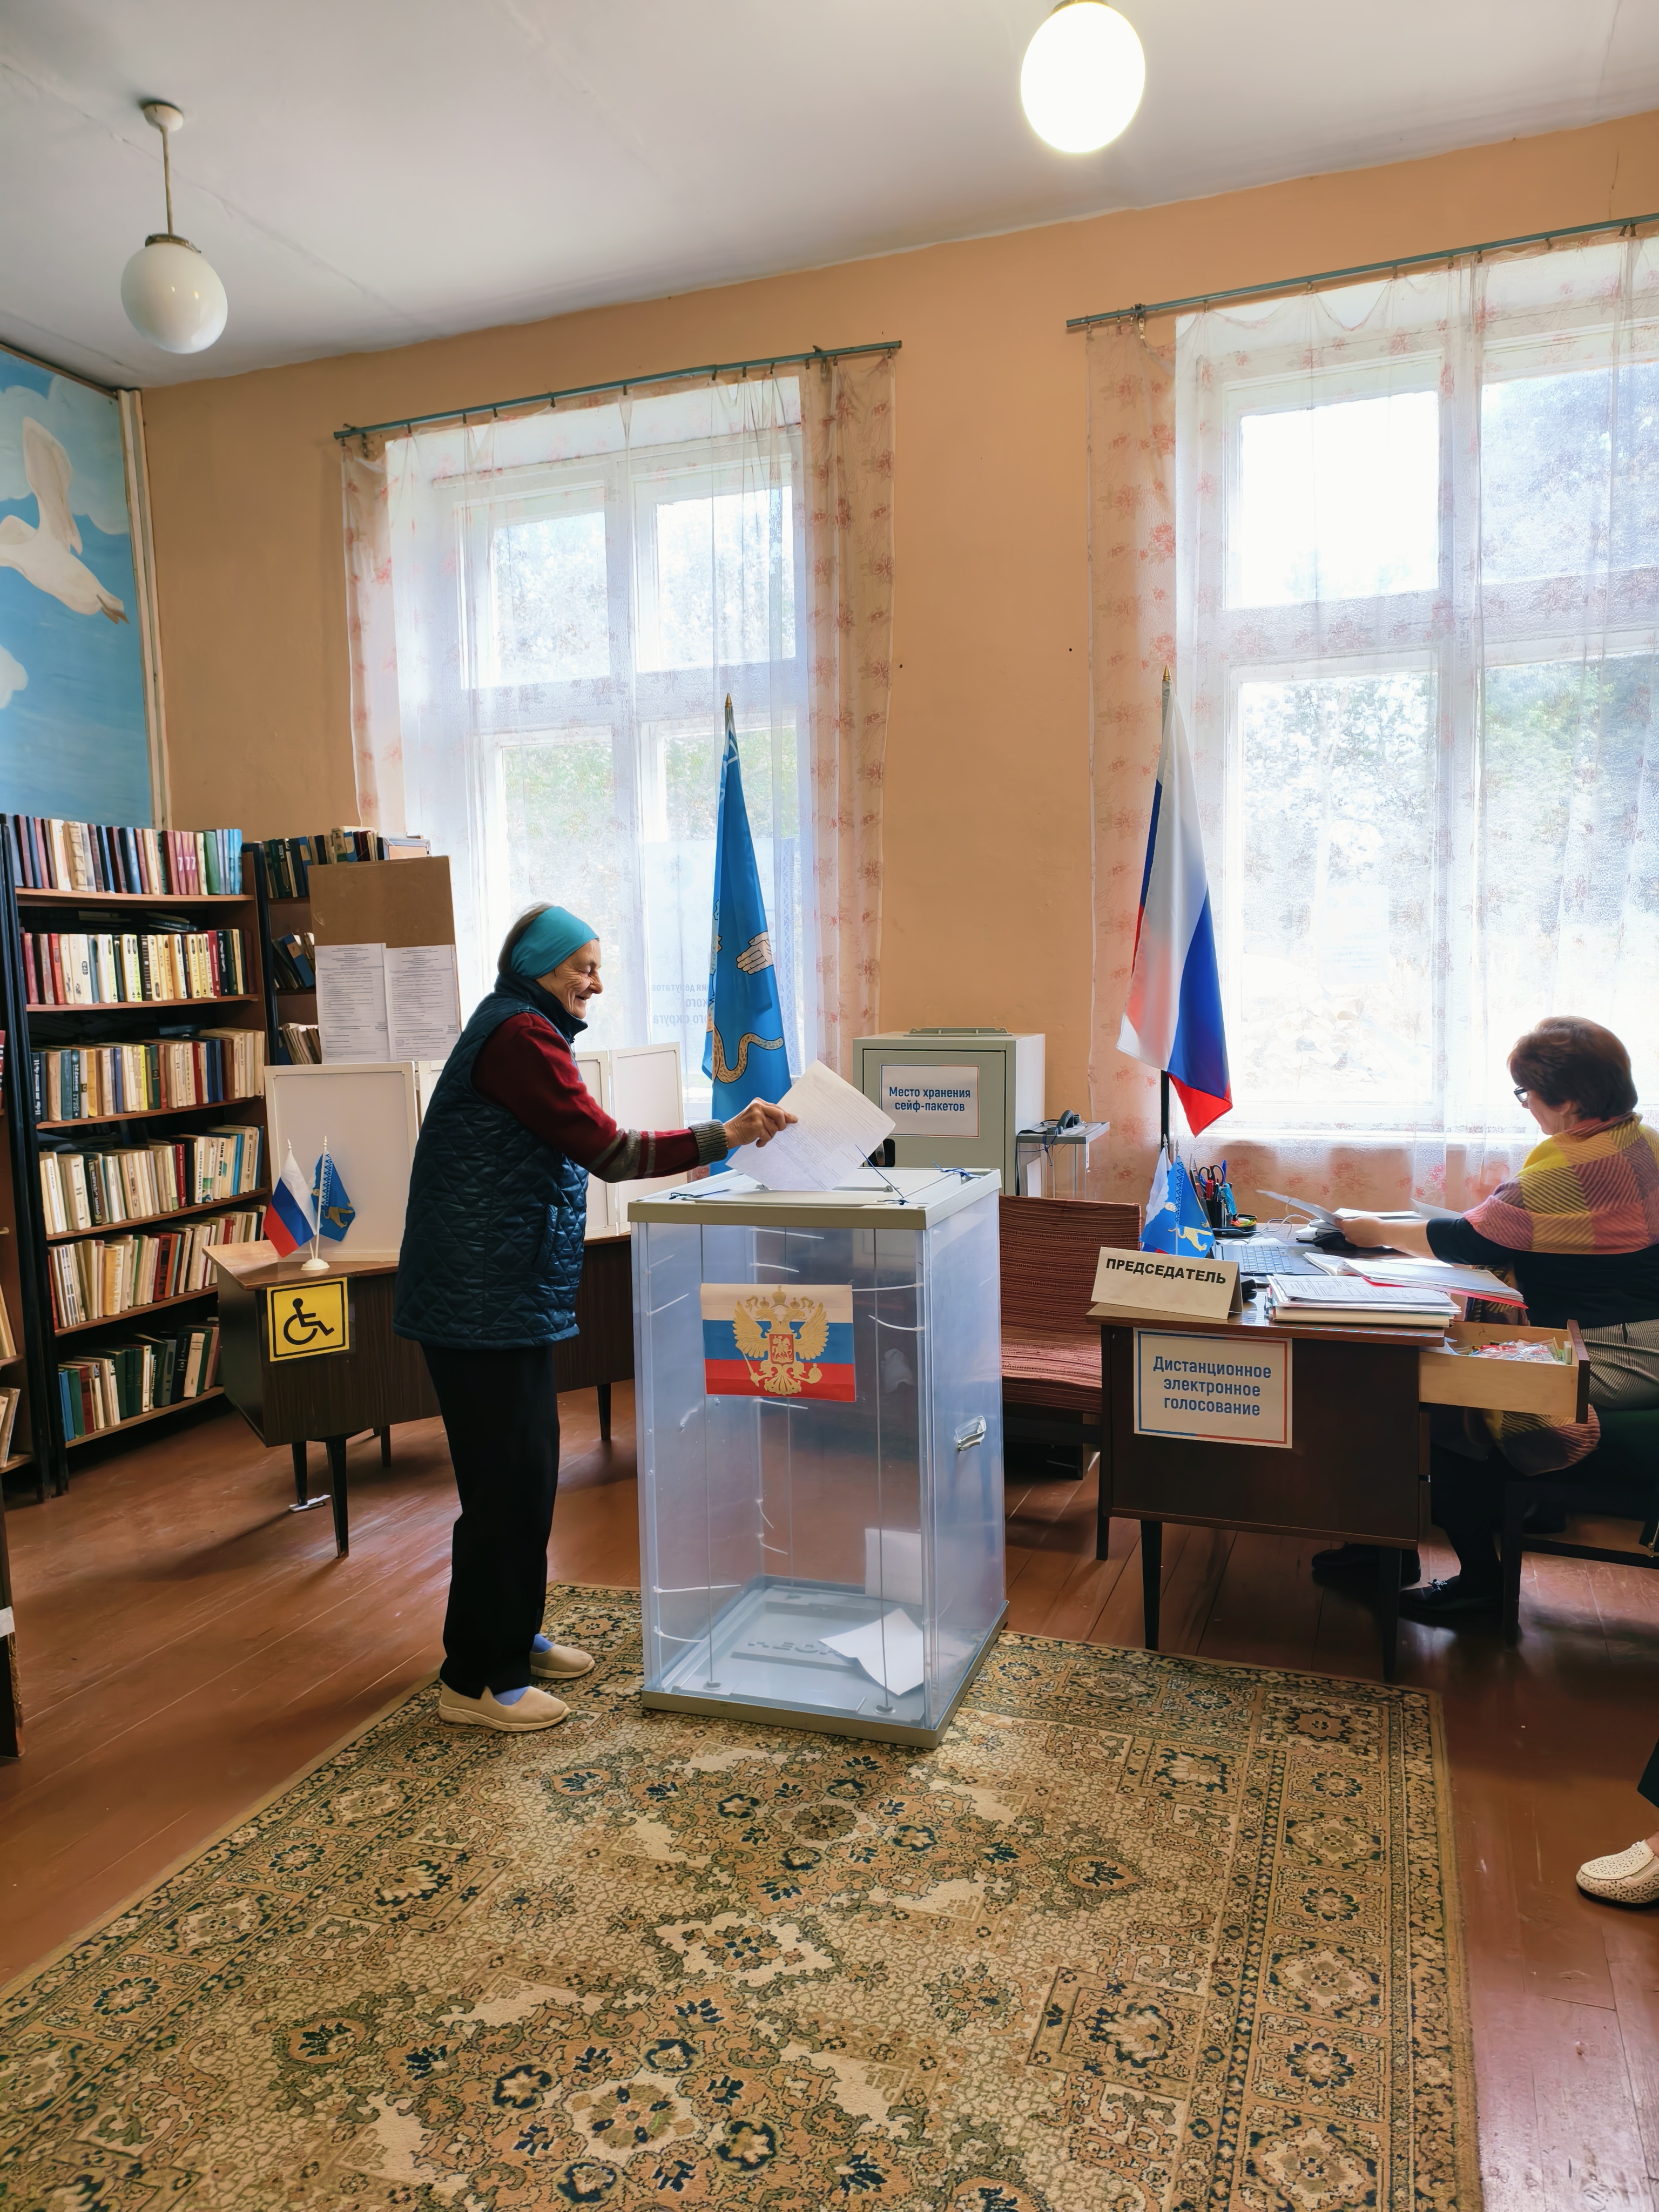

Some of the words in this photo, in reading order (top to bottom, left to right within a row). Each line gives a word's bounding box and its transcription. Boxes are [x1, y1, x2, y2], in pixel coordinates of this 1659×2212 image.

[889, 1087, 920, 1097] Место
[923, 1089, 970, 1099] хранения
[895, 1100, 965, 1112] сейф-пакетов
[1106, 1258, 1226, 1284] ПРЕДСЕДАТЕЛЬ
[1153, 1356, 1271, 1379] Дистанционное
[1164, 1378, 1261, 1397] электронное
[1164, 1397, 1260, 1416] голосование
